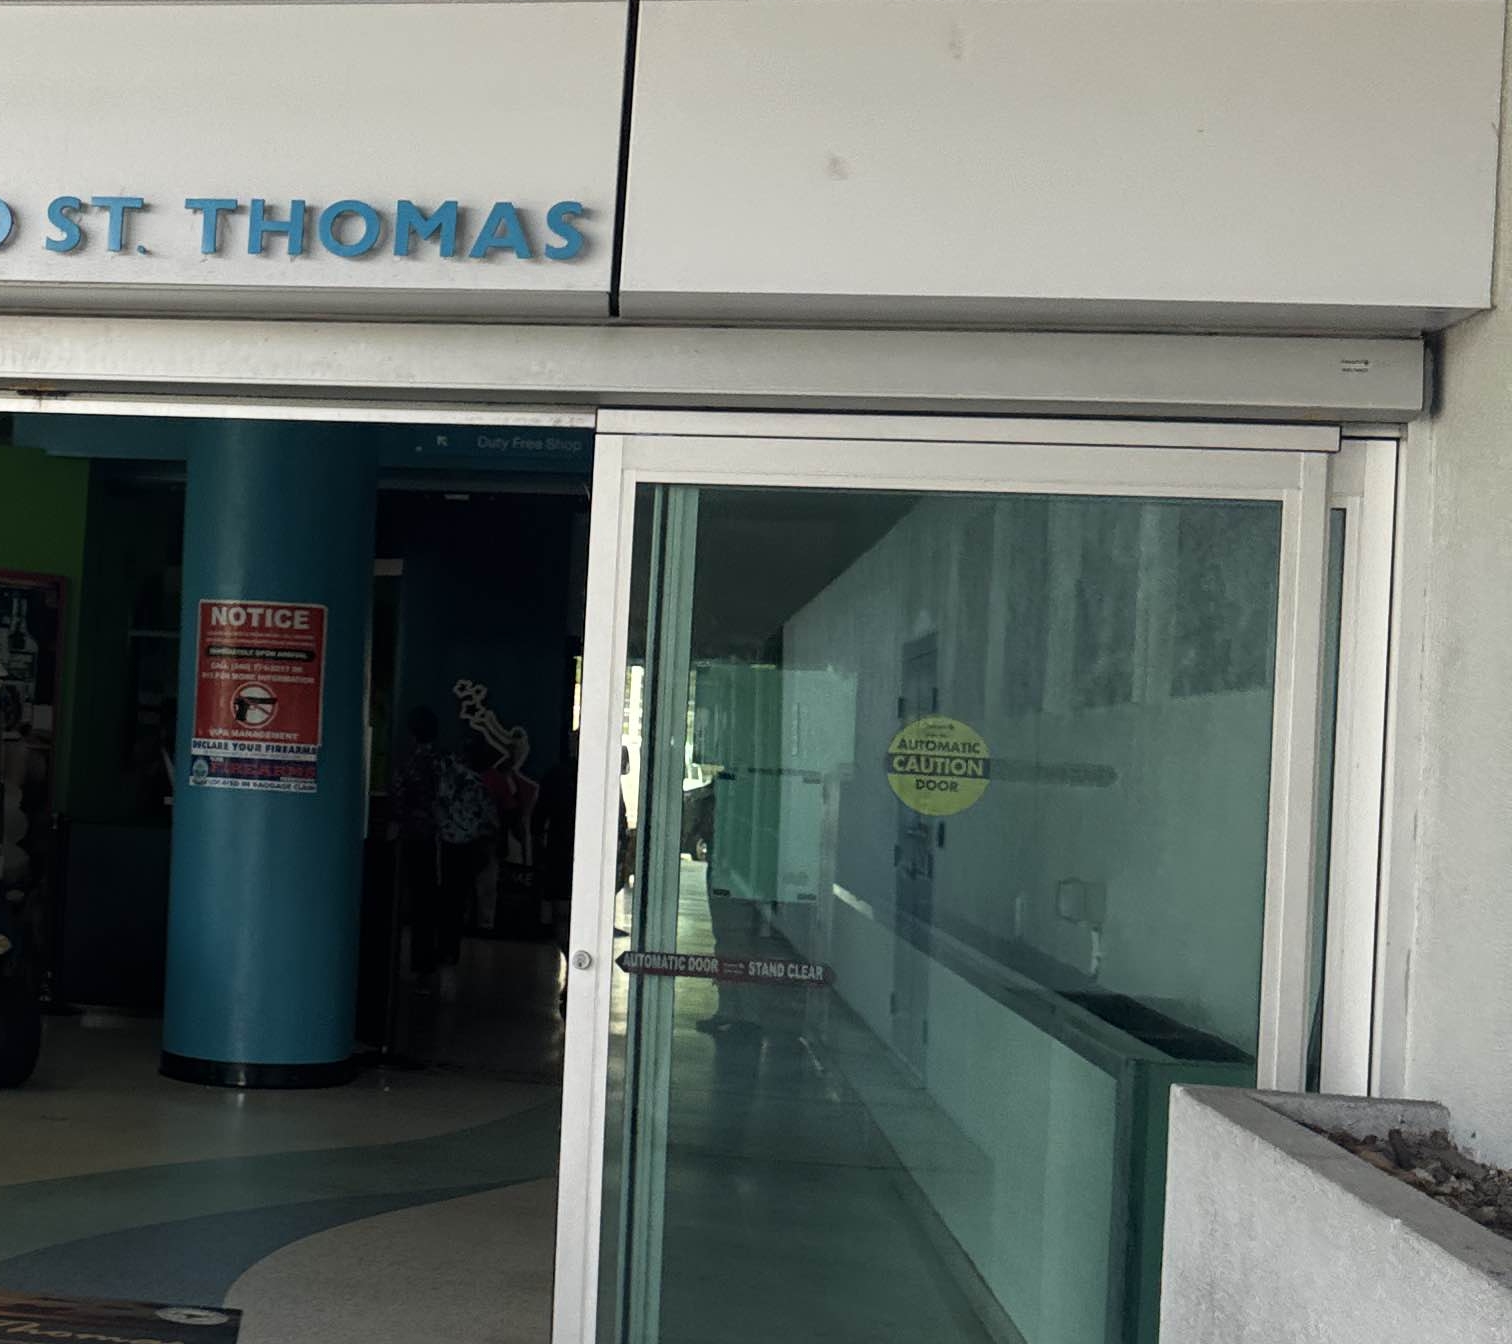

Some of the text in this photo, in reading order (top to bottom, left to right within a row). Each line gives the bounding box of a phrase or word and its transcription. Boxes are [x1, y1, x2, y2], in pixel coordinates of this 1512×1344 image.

[46, 194, 150, 256] ST.
[185, 197, 588, 260] THOMAS
[477, 435, 511, 451] Duty
[512, 437, 543, 450] Free
[211, 606, 310, 629] NOTICE
[232, 742, 262, 752] YOUR
[897, 738, 981, 754] AUTOMATIC
[892, 755, 983, 776] CAUTION
[915, 778, 960, 793] DOOR
[622, 953, 686, 971] AUTOMATIC
[688, 957, 719, 973] DOOR
[748, 961, 785, 977] STAND
[788, 964, 824, 981] CLEAR
